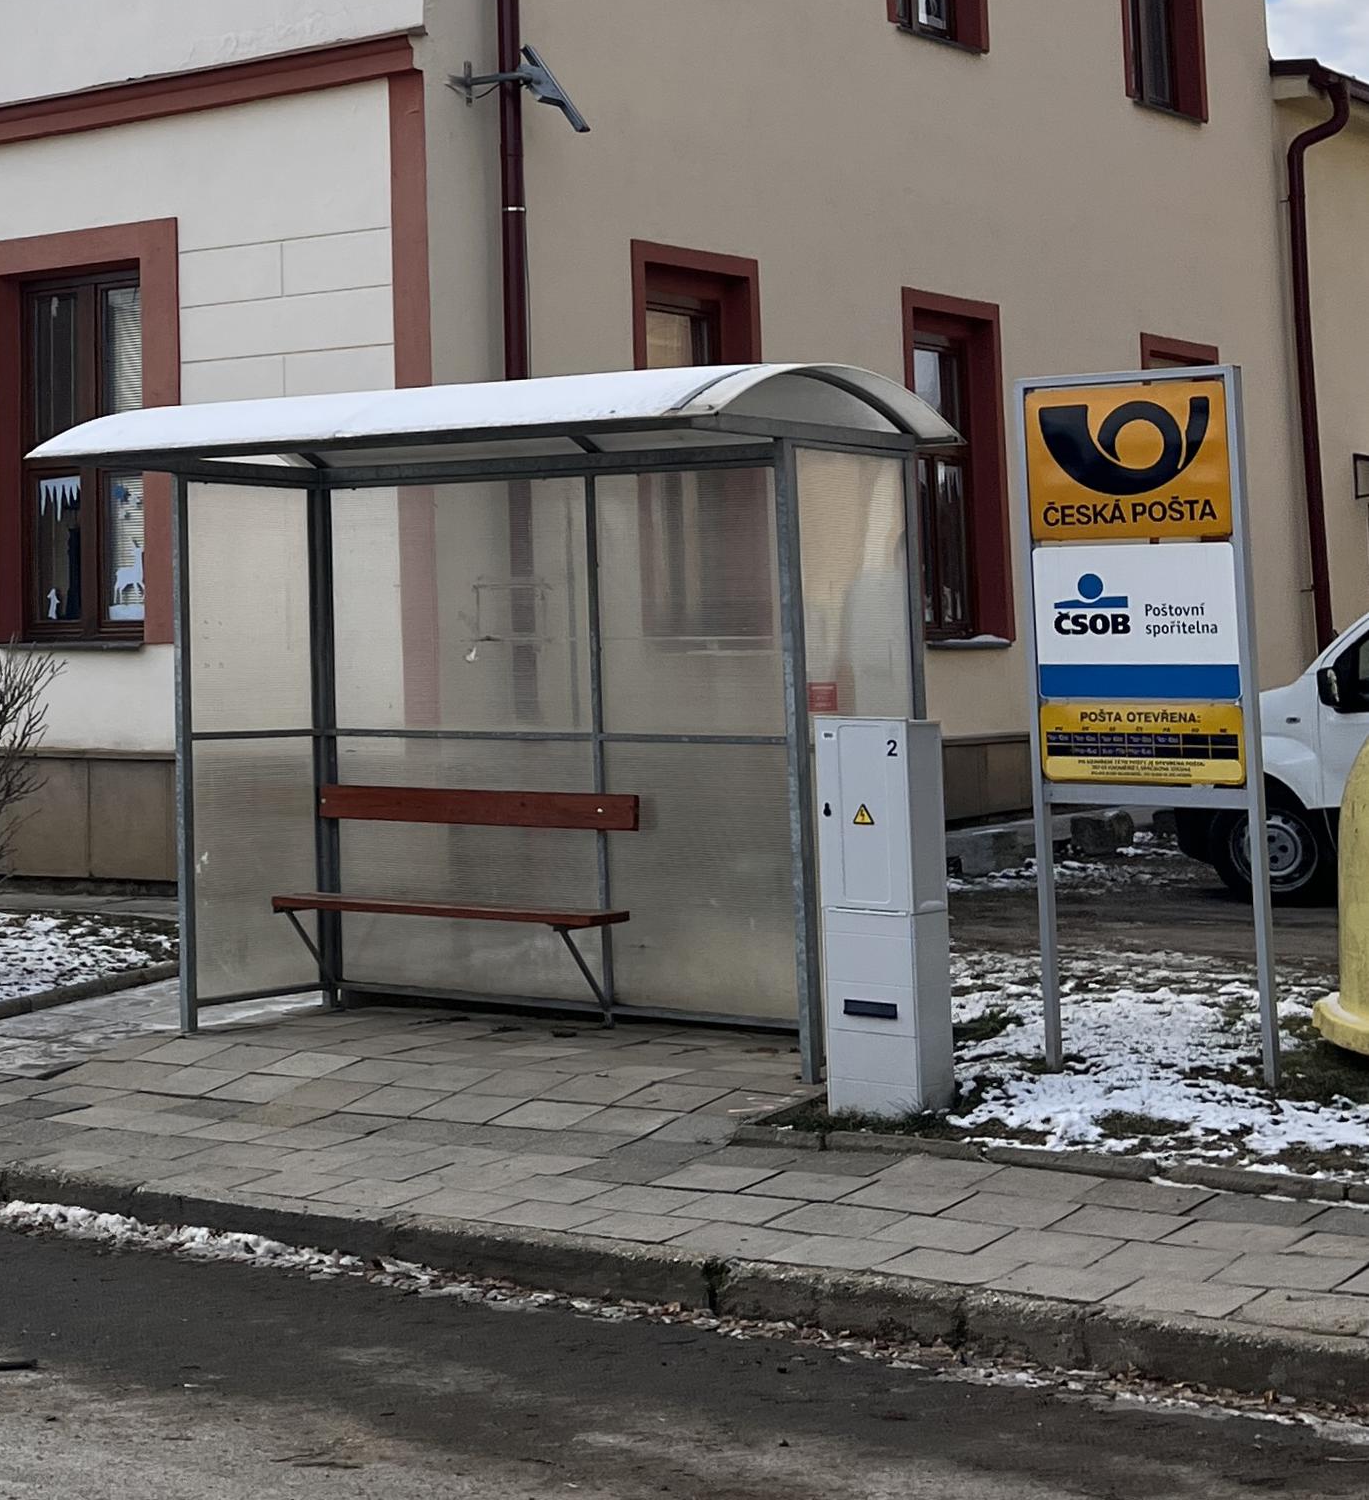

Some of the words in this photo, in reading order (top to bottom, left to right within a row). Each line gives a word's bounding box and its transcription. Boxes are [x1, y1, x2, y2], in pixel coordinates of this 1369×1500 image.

[1043, 499, 1126, 527] ČESKÁ
[1131, 496, 1218, 523] POŠTA
[1145, 602, 1205, 617] Poštovní
[1054, 611, 1131, 636] ČSOB
[1145, 621, 1218, 638] spořitelna
[1080, 709, 1122, 723] POŠTA
[1127, 709, 1201, 724] OTEVŘENA:
[886, 739, 898, 757] 2
